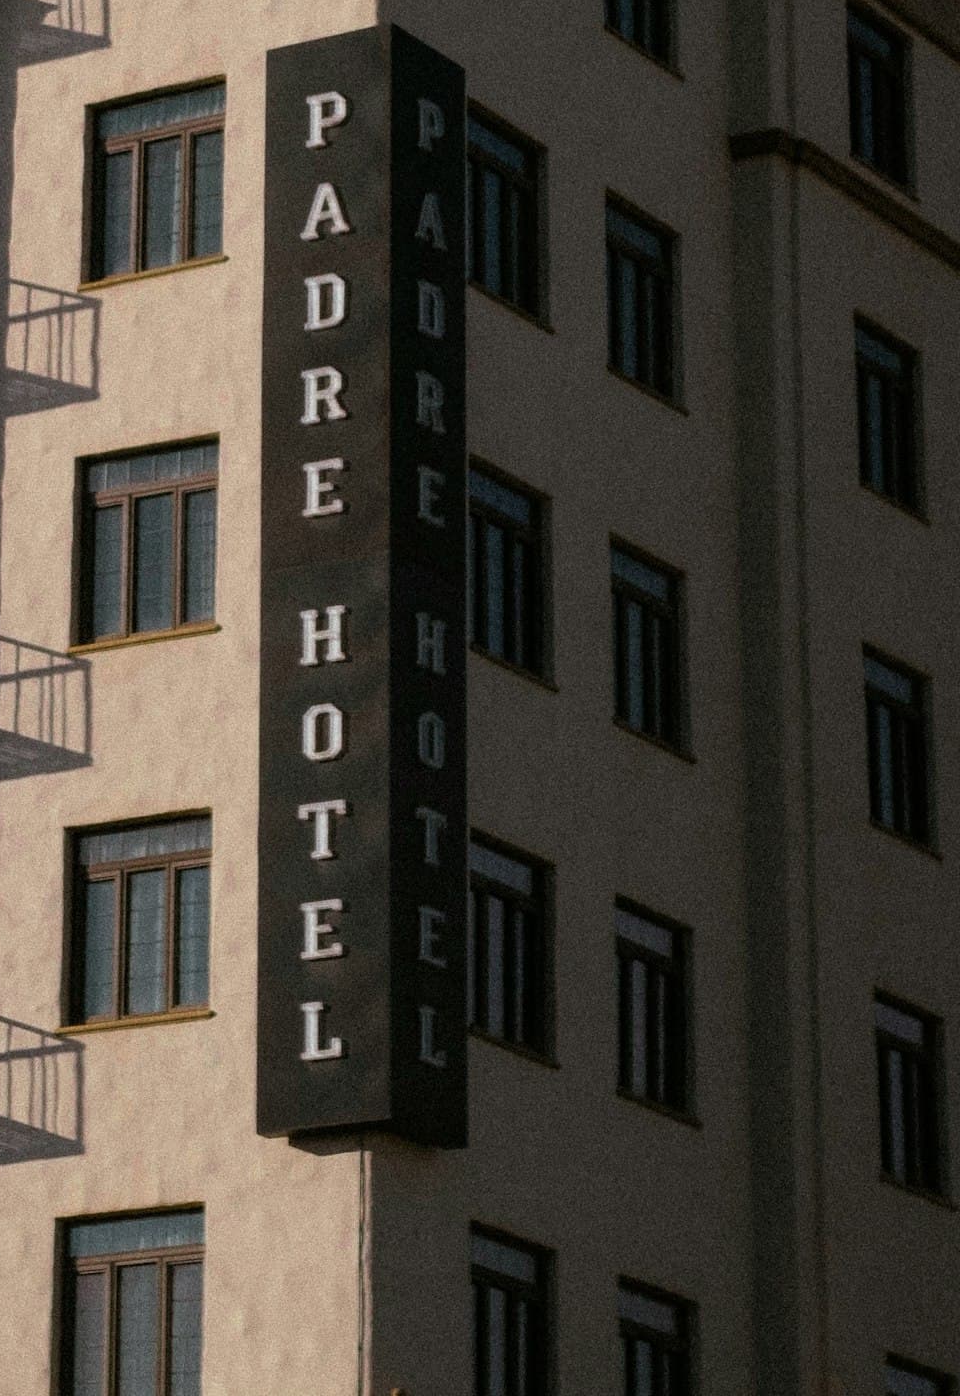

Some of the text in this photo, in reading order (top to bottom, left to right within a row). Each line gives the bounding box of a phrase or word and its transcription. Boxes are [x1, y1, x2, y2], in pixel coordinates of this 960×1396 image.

[298, 91, 350, 1061] PADRE HOTEL
[415, 98, 447, 1068] PADRE HOTEL
